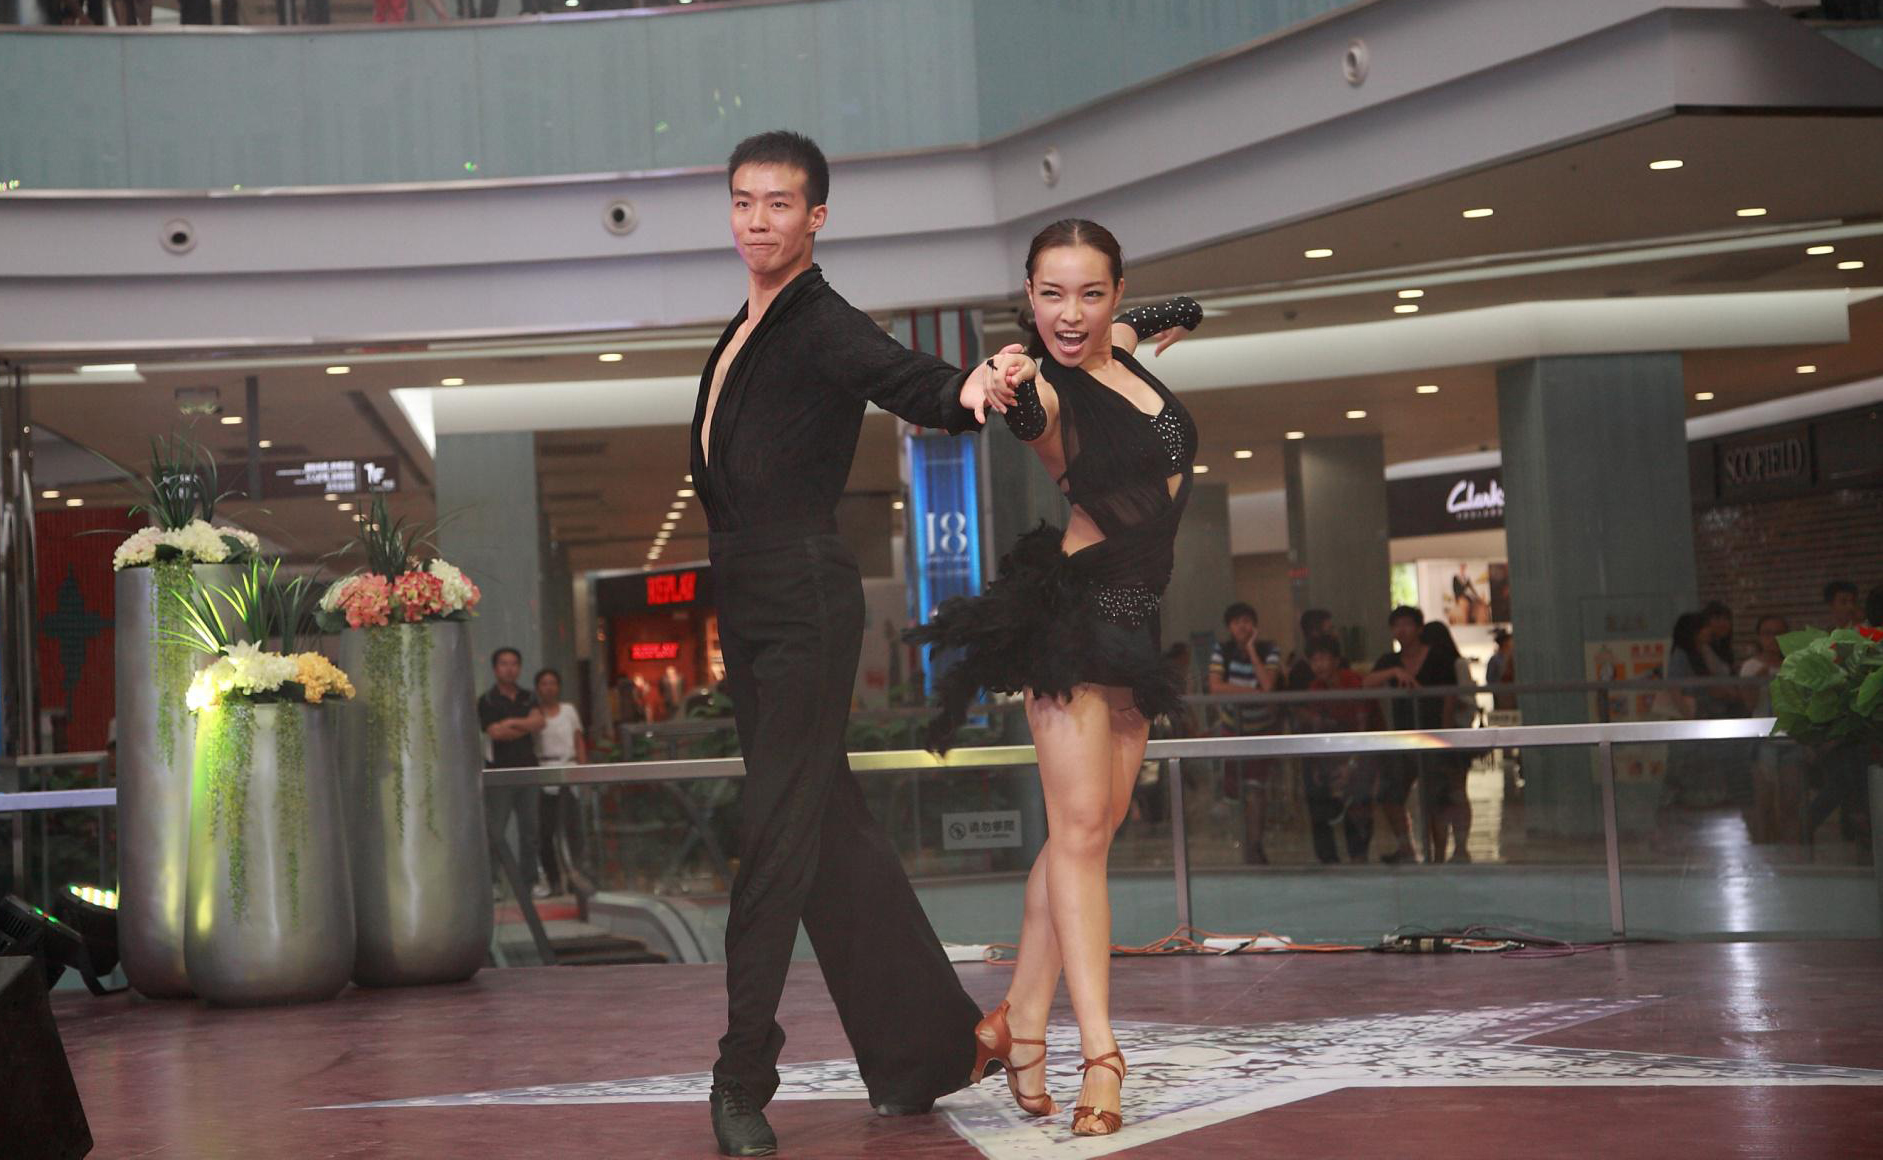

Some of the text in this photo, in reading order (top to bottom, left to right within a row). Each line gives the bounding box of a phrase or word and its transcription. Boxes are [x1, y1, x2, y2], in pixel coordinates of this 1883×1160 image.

[1446, 479, 1505, 513] Clark
[926, 511, 968, 554] 18
[646, 571, 697, 606] REPLAY
